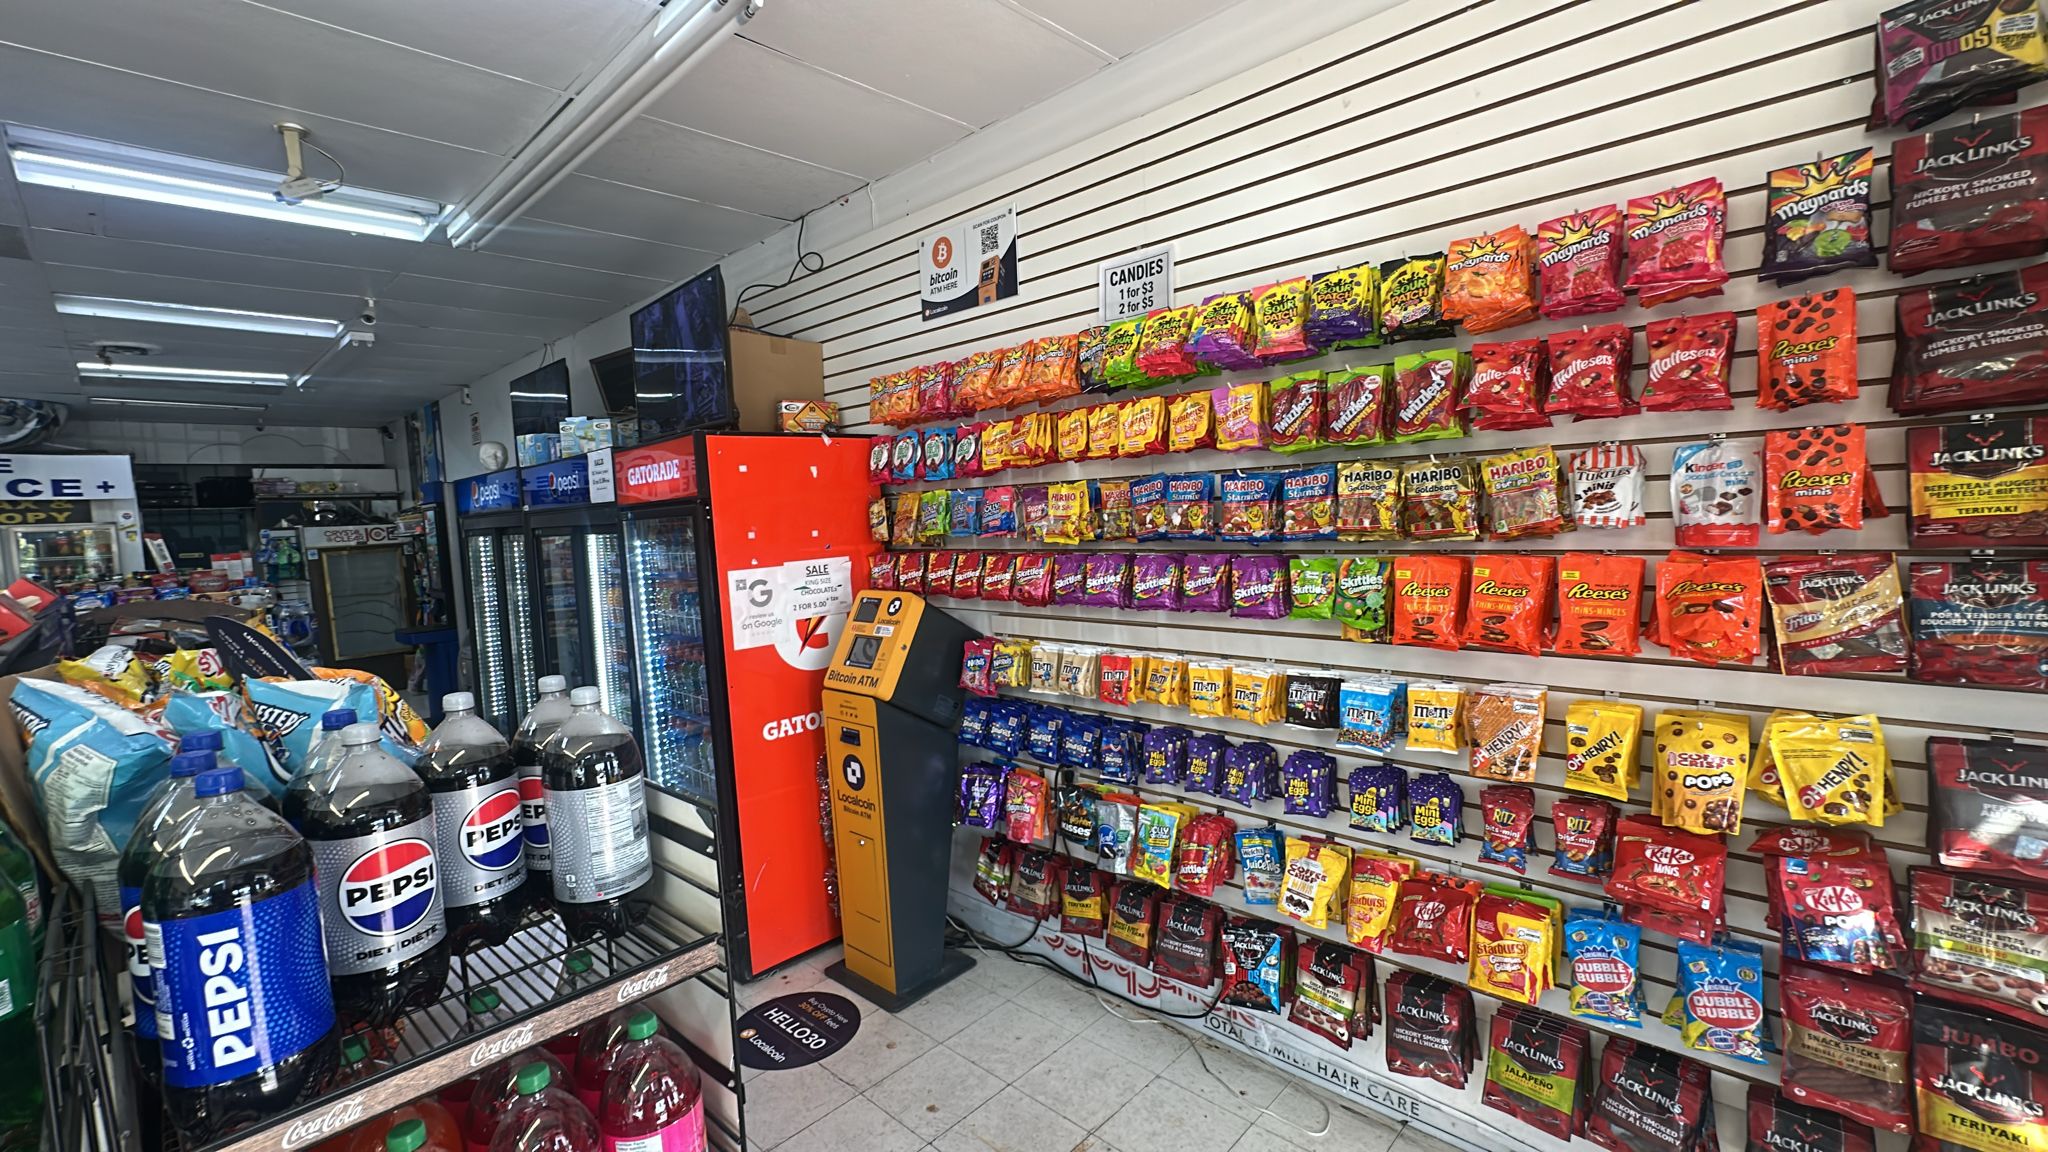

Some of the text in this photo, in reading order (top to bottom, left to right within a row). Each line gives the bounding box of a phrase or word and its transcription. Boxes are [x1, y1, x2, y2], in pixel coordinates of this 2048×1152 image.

[1913, 151, 1966, 174] JACK
[1913, 169, 2032, 200] HICKORY SMOKED
[929, 267, 958, 287] bitcoin
[1110, 258, 1164, 287] CANDIES
[930, 280, 958, 296] ATM HERE
[1119, 281, 1154, 300] 1 for $3
[1319, 283, 1352, 294] SOUR
[1394, 277, 1427, 296] SOUR
[1317, 290, 1352, 302] PATCH
[1391, 287, 1429, 306] PATCH
[1119, 296, 1154, 315] 2 for $5
[1264, 300, 1297, 314] SOUR
[1263, 310, 1298, 324] PATCH
[1924, 305, 1975, 328] JACK
[1928, 323, 2045, 350] HICKORY SMOKED
[1769, 336, 1839, 361] Reese's
[1649, 347, 1717, 382] Maltesers
[1782, 354, 1819, 367] minis
[1399, 370, 1448, 423] Twizzlers
[1332, 391, 1375, 433] Twizzlers
[1412, 388, 1451, 426] GUMMIES
[1343, 402, 1378, 436] GUMMIES
[1930, 452, 1981, 466] JACK
[628, 460, 680, 486] GATORADE
[1344, 469, 1394, 484] HARIBO
[1410, 468, 1461, 485] HARIBO
[1489, 456, 1545, 480] HARIBO
[1577, 468, 1632, 480] TURTLES
[558, 471, 580, 492] pepsi
[1132, 480, 1163, 497] HARIBO
[1169, 480, 1204, 492] HARIBO
[1223, 480, 1265, 492] HARIBO
[1285, 473, 1329, 488] HARIBO
[480, 480, 501, 507] pepsi
[1414, 484, 1459, 495] Goldbears
[1794, 486, 1833, 498] minis
[1978, 488, 1993, 496] DE
[1956, 505, 2018, 515] TERIYAKI
[806, 564, 829, 575] SALE
[805, 577, 832, 587] KING SIZE
[1135, 575, 1170, 593] Skittles
[1185, 575, 1217, 590] Skittles
[1291, 584, 1327, 596] Skittles
[1340, 575, 1384, 590] Skittles
[1401, 580, 1450, 598] Reese's
[1475, 580, 1530, 598] Reese's
[1234, 582, 1275, 600] Skittles
[1567, 583, 1631, 601] Reese's
[793, 604, 797, 612] 2
[799, 602, 812, 611] FOR
[813, 601, 828, 609] 5.00
[742, 617, 783, 631] on Google
[1784, 612, 1824, 631] Fritos
[828, 669, 880, 689] Bitcoin ATM
[763, 710, 823, 742] GATO
[1472, 719, 1529, 769] OH HENRY!
[1567, 731, 1623, 772] OH HENRY!
[1149, 751, 1166, 761] Mini
[1149, 759, 1166, 768] Eggs
[1191, 758, 1208, 768] Mini
[1190, 766, 1208, 776] Eggs
[1229, 768, 1245, 779] Mini
[1957, 768, 2007, 787] JACK
[1228, 777, 1245, 787] Eggs
[1289, 779, 1309, 789] Mini
[1684, 772, 1734, 789] POPS
[1801, 751, 1870, 809] OH HENRY!
[1288, 786, 1310, 797] Eggs
[1354, 794, 1377, 806] Mini
[837, 789, 877, 812] Localcoin
[1352, 803, 1378, 816] Eggs
[1492, 808, 1517, 825] RITZ
[1567, 816, 1592, 833] RITZ
[1648, 848, 1692, 865] KitKat
[346, 863, 435, 908] PEPSI
[474, 879, 503, 893] DIET
[1811, 888, 1862, 912] KitKat
[1942, 896, 1984, 915] JACK
[356, 945, 395, 962] DIET
[1476, 940, 1528, 957] Starburst
[1583, 949, 1610, 959] ORIGINAL
[1575, 961, 1625, 975] DUBBLE
[1575, 972, 1629, 985] BUBBLE
[196, 926, 262, 1068] PEPSI
[1692, 995, 1753, 1009] DUBBLE
[1395, 1003, 1421, 1018] JACK
[1695, 1007, 1755, 1021] BUBBLE
[1808, 1008, 1840, 1025] JACK
[763, 1007, 827, 1050] HELLO30
[749, 1034, 787, 1064] Localcoin
[1501, 1036, 1531, 1058] JACK
[1807, 1033, 1880, 1060] SNACK STICKS
[1940, 1024, 2040, 1065] JUMBO
[1317, 1061, 1360, 1090] HAIR
[1367, 1083, 1421, 1117] CARE
[1611, 1071, 1644, 1097] JACK
[1606, 1096, 1679, 1138] HICKORY SMOKED
[1947, 1112, 2029, 1146] TERIYAKI
